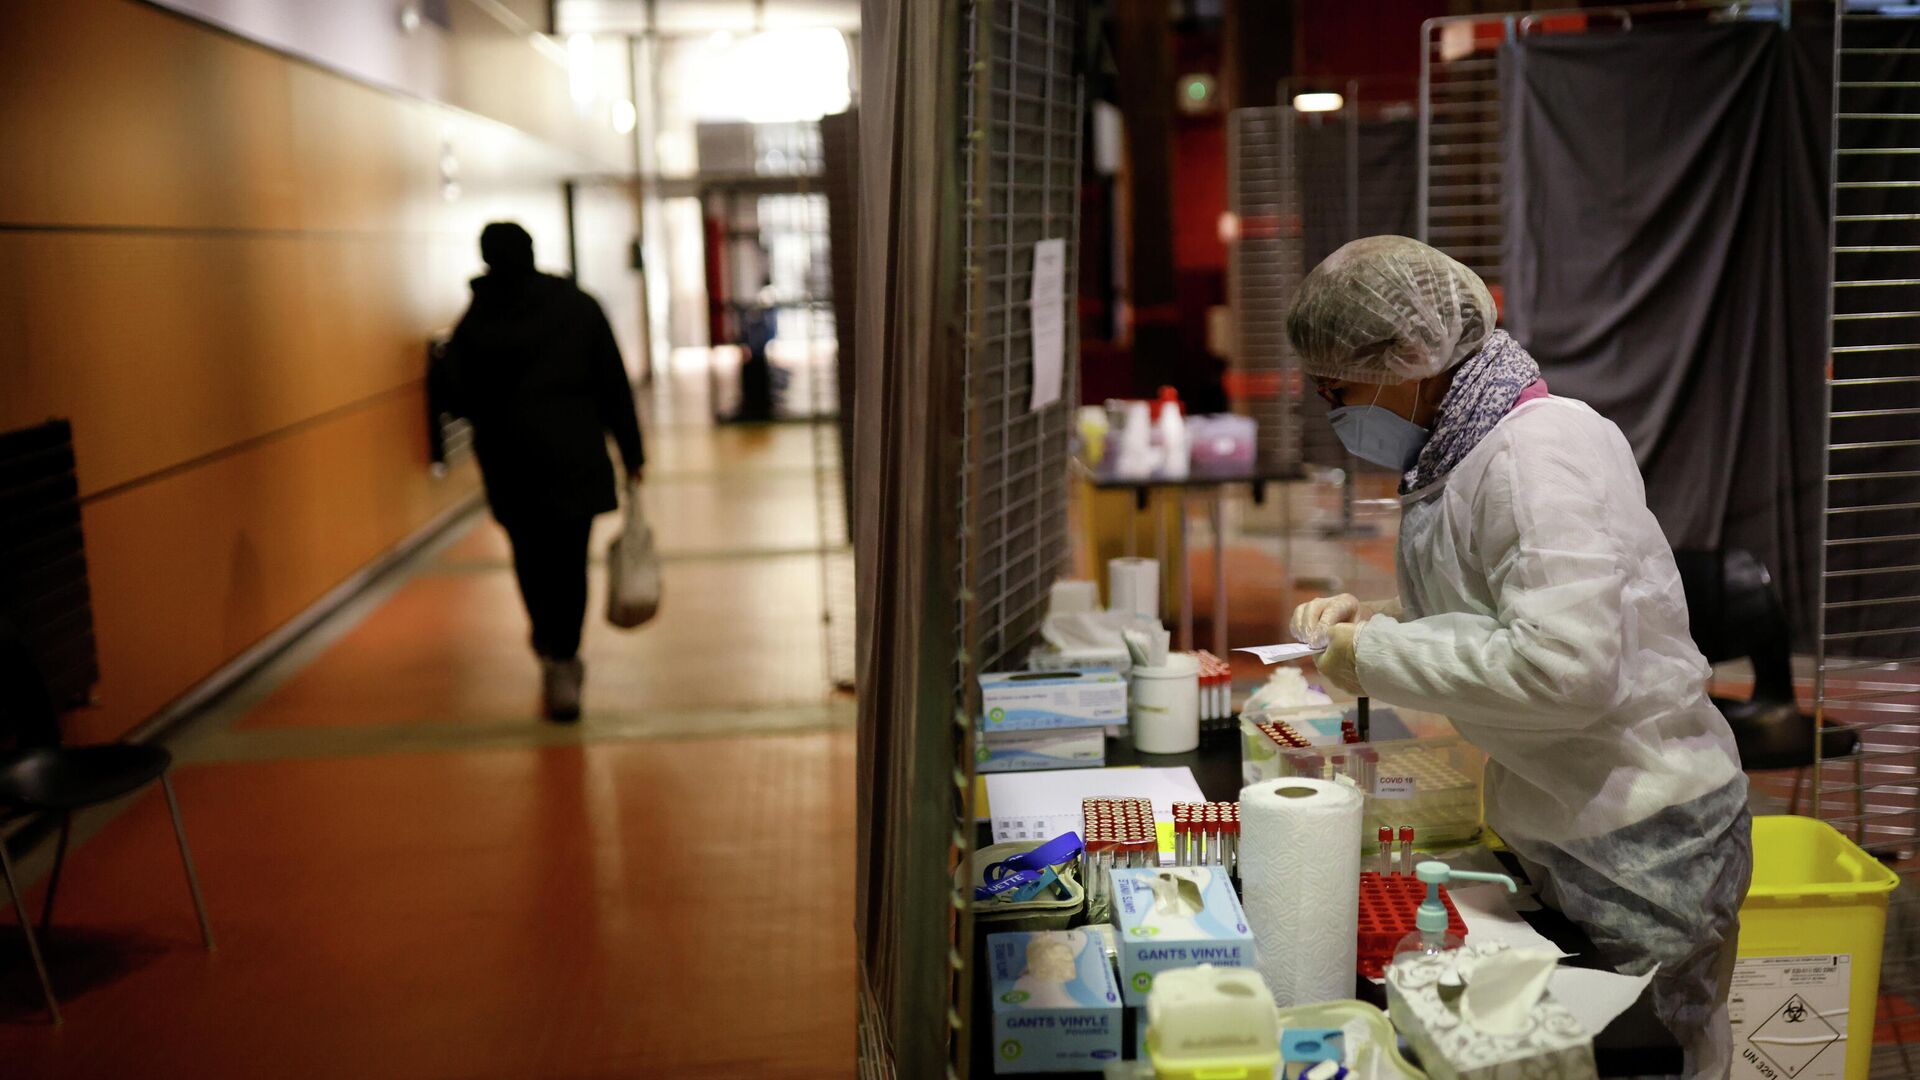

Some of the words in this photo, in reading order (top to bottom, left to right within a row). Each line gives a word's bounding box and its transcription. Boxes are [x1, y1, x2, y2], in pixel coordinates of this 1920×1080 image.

[1138, 948, 1187, 961] GANTS
[1191, 946, 1241, 959] VINYLE
[1007, 1016, 1055, 1029] GANTS
[1059, 1015, 1109, 1027] VINYLE
[1743, 1048, 1759, 1064] UN
[1756, 1061, 1778, 1080] 3291
